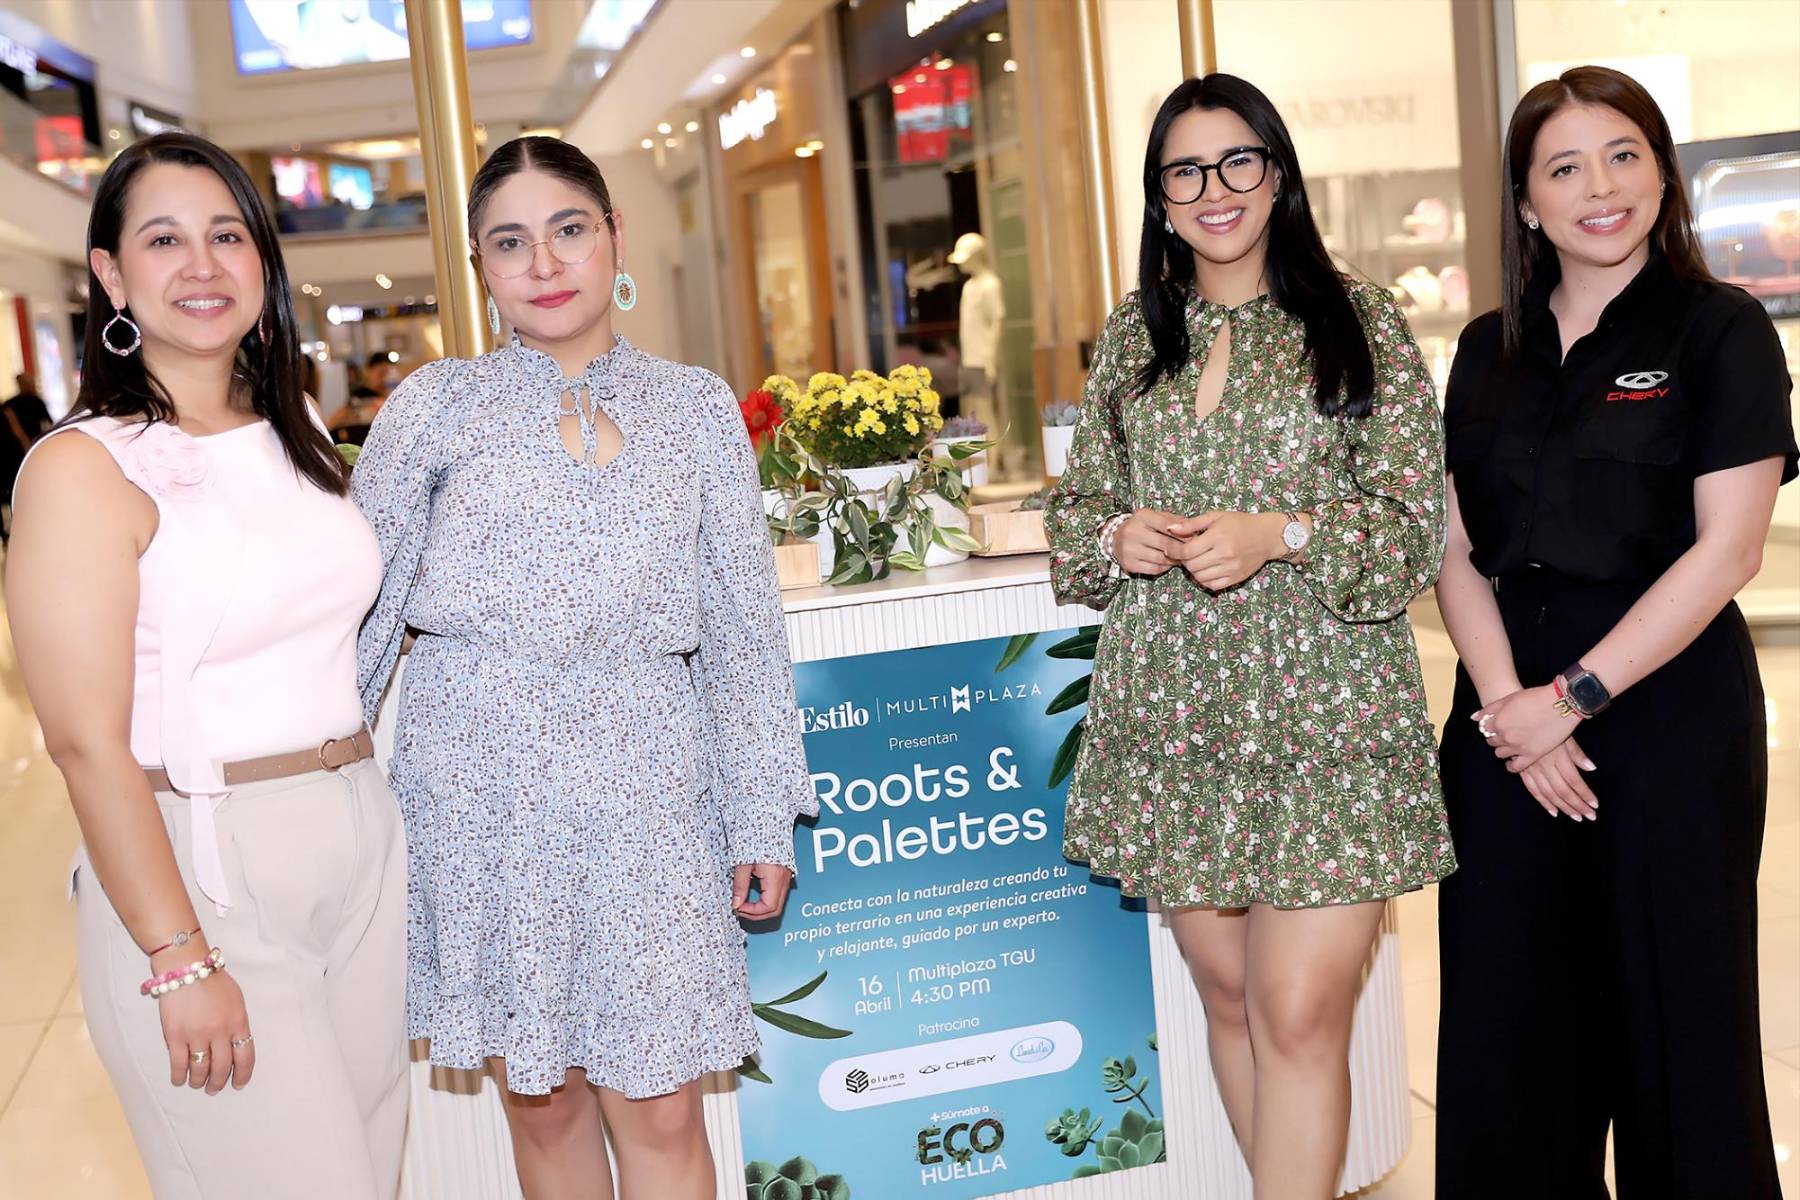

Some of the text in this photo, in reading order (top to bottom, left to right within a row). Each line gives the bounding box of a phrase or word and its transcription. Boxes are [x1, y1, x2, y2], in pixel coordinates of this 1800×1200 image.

[1606, 387, 1669, 401] CHERY
[800, 701, 869, 733] Estilo
[889, 731, 958, 750] Presentan
[809, 746, 1022, 815] Roots &
[812, 807, 1048, 873] Palettes
[801, 864, 1068, 918] Conecta con la naturaleza creando tu
[784, 883, 1088, 946] propio terrario en una experiencia creativa
[817, 910, 1060, 963] y relajante, guiado por un experto.
[908, 948, 1037, 982] Multiplaza TGU
[858, 976, 883, 996] 16
[911, 977, 990, 1006] 4:30 PM
[855, 996, 891, 1016] Abril
[918, 1016, 980, 1036] Patrocina
[945, 1054, 996, 1070] CHERY
[982, 1105, 989, 1113] a
[917, 1118, 1004, 1165] ECO
[920, 1154, 1007, 1186] HUELLA
